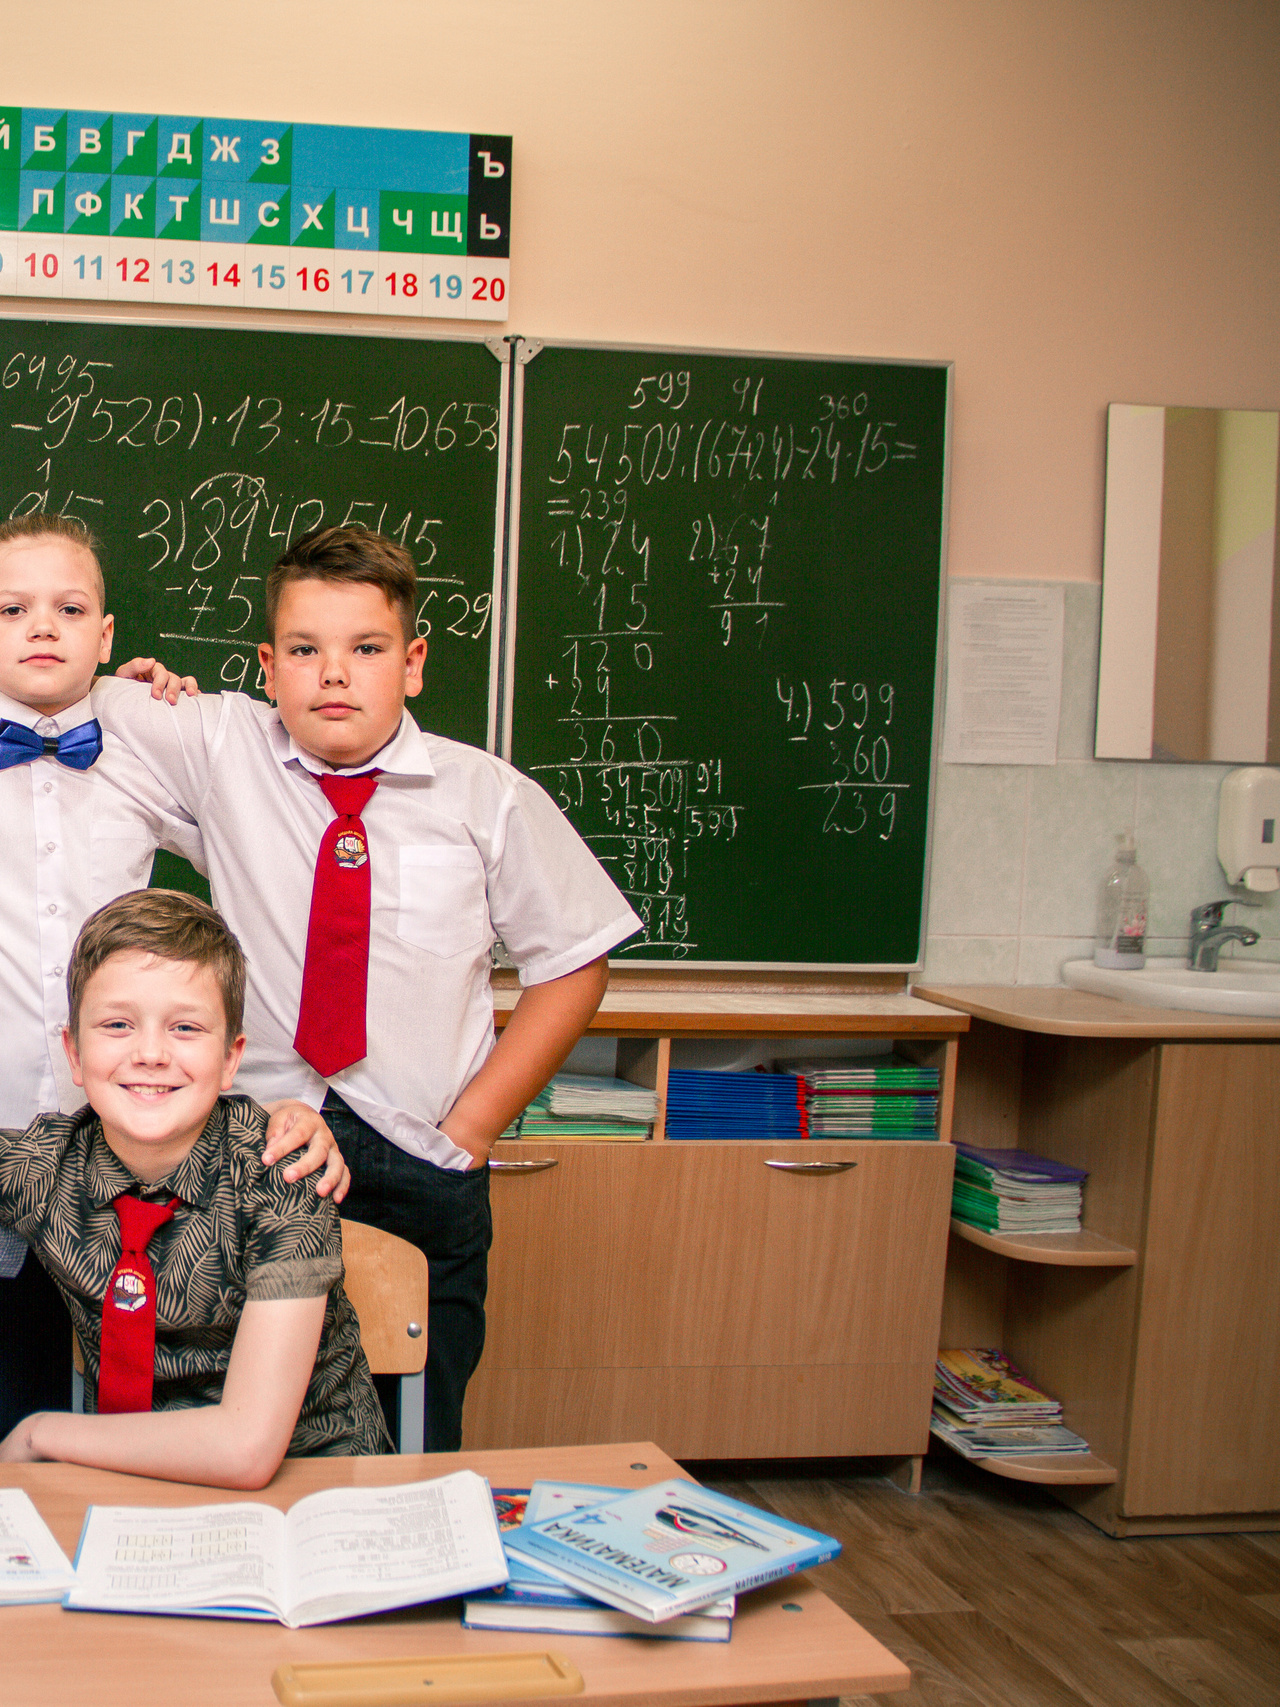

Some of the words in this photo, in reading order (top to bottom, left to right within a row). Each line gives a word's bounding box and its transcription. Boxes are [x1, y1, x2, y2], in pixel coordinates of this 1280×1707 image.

[33, 124, 56, 152] Б
[79, 127, 102, 154] В
[126, 129, 146, 156] Г
[167, 132, 193, 165] Д
[209, 134, 242, 163] Ж
[260, 138, 280, 165] З
[477, 152, 505, 178] Ъ
[32, 187, 55, 215] П
[74, 190, 103, 217] Ф
[124, 192, 145, 220] К
[168, 195, 190, 222] Т
[209, 197, 241, 226] Ш
[257, 200, 280, 228] С
[301, 203, 324, 230] Х
[346, 205, 370, 239] Ц
[392, 209, 413, 235] Ч
[430, 211, 463, 243] Щ
[480, 214, 501, 240] Ь
[24, 252, 59, 279] 10
[73, 254, 102, 281] 11
[115, 256, 151, 284] 12
[161, 259, 195, 285] 13
[206, 261, 242, 288] 14
[252, 263, 286, 290] 15
[296, 266, 331, 293] 16
[341, 269, 375, 295] 17
[384, 271, 419, 298] 18
[429, 274, 463, 299] 19
[471, 276, 506, 303] 20
[628, 371, 691, 409] 599
[593, 583, 649, 631] 15
[561, 640, 652, 676] 120
[542, 1521, 690, 1588] МАТЕМАТИКА
[735, 1567, 784, 1590] МАТЕМАТИКА
